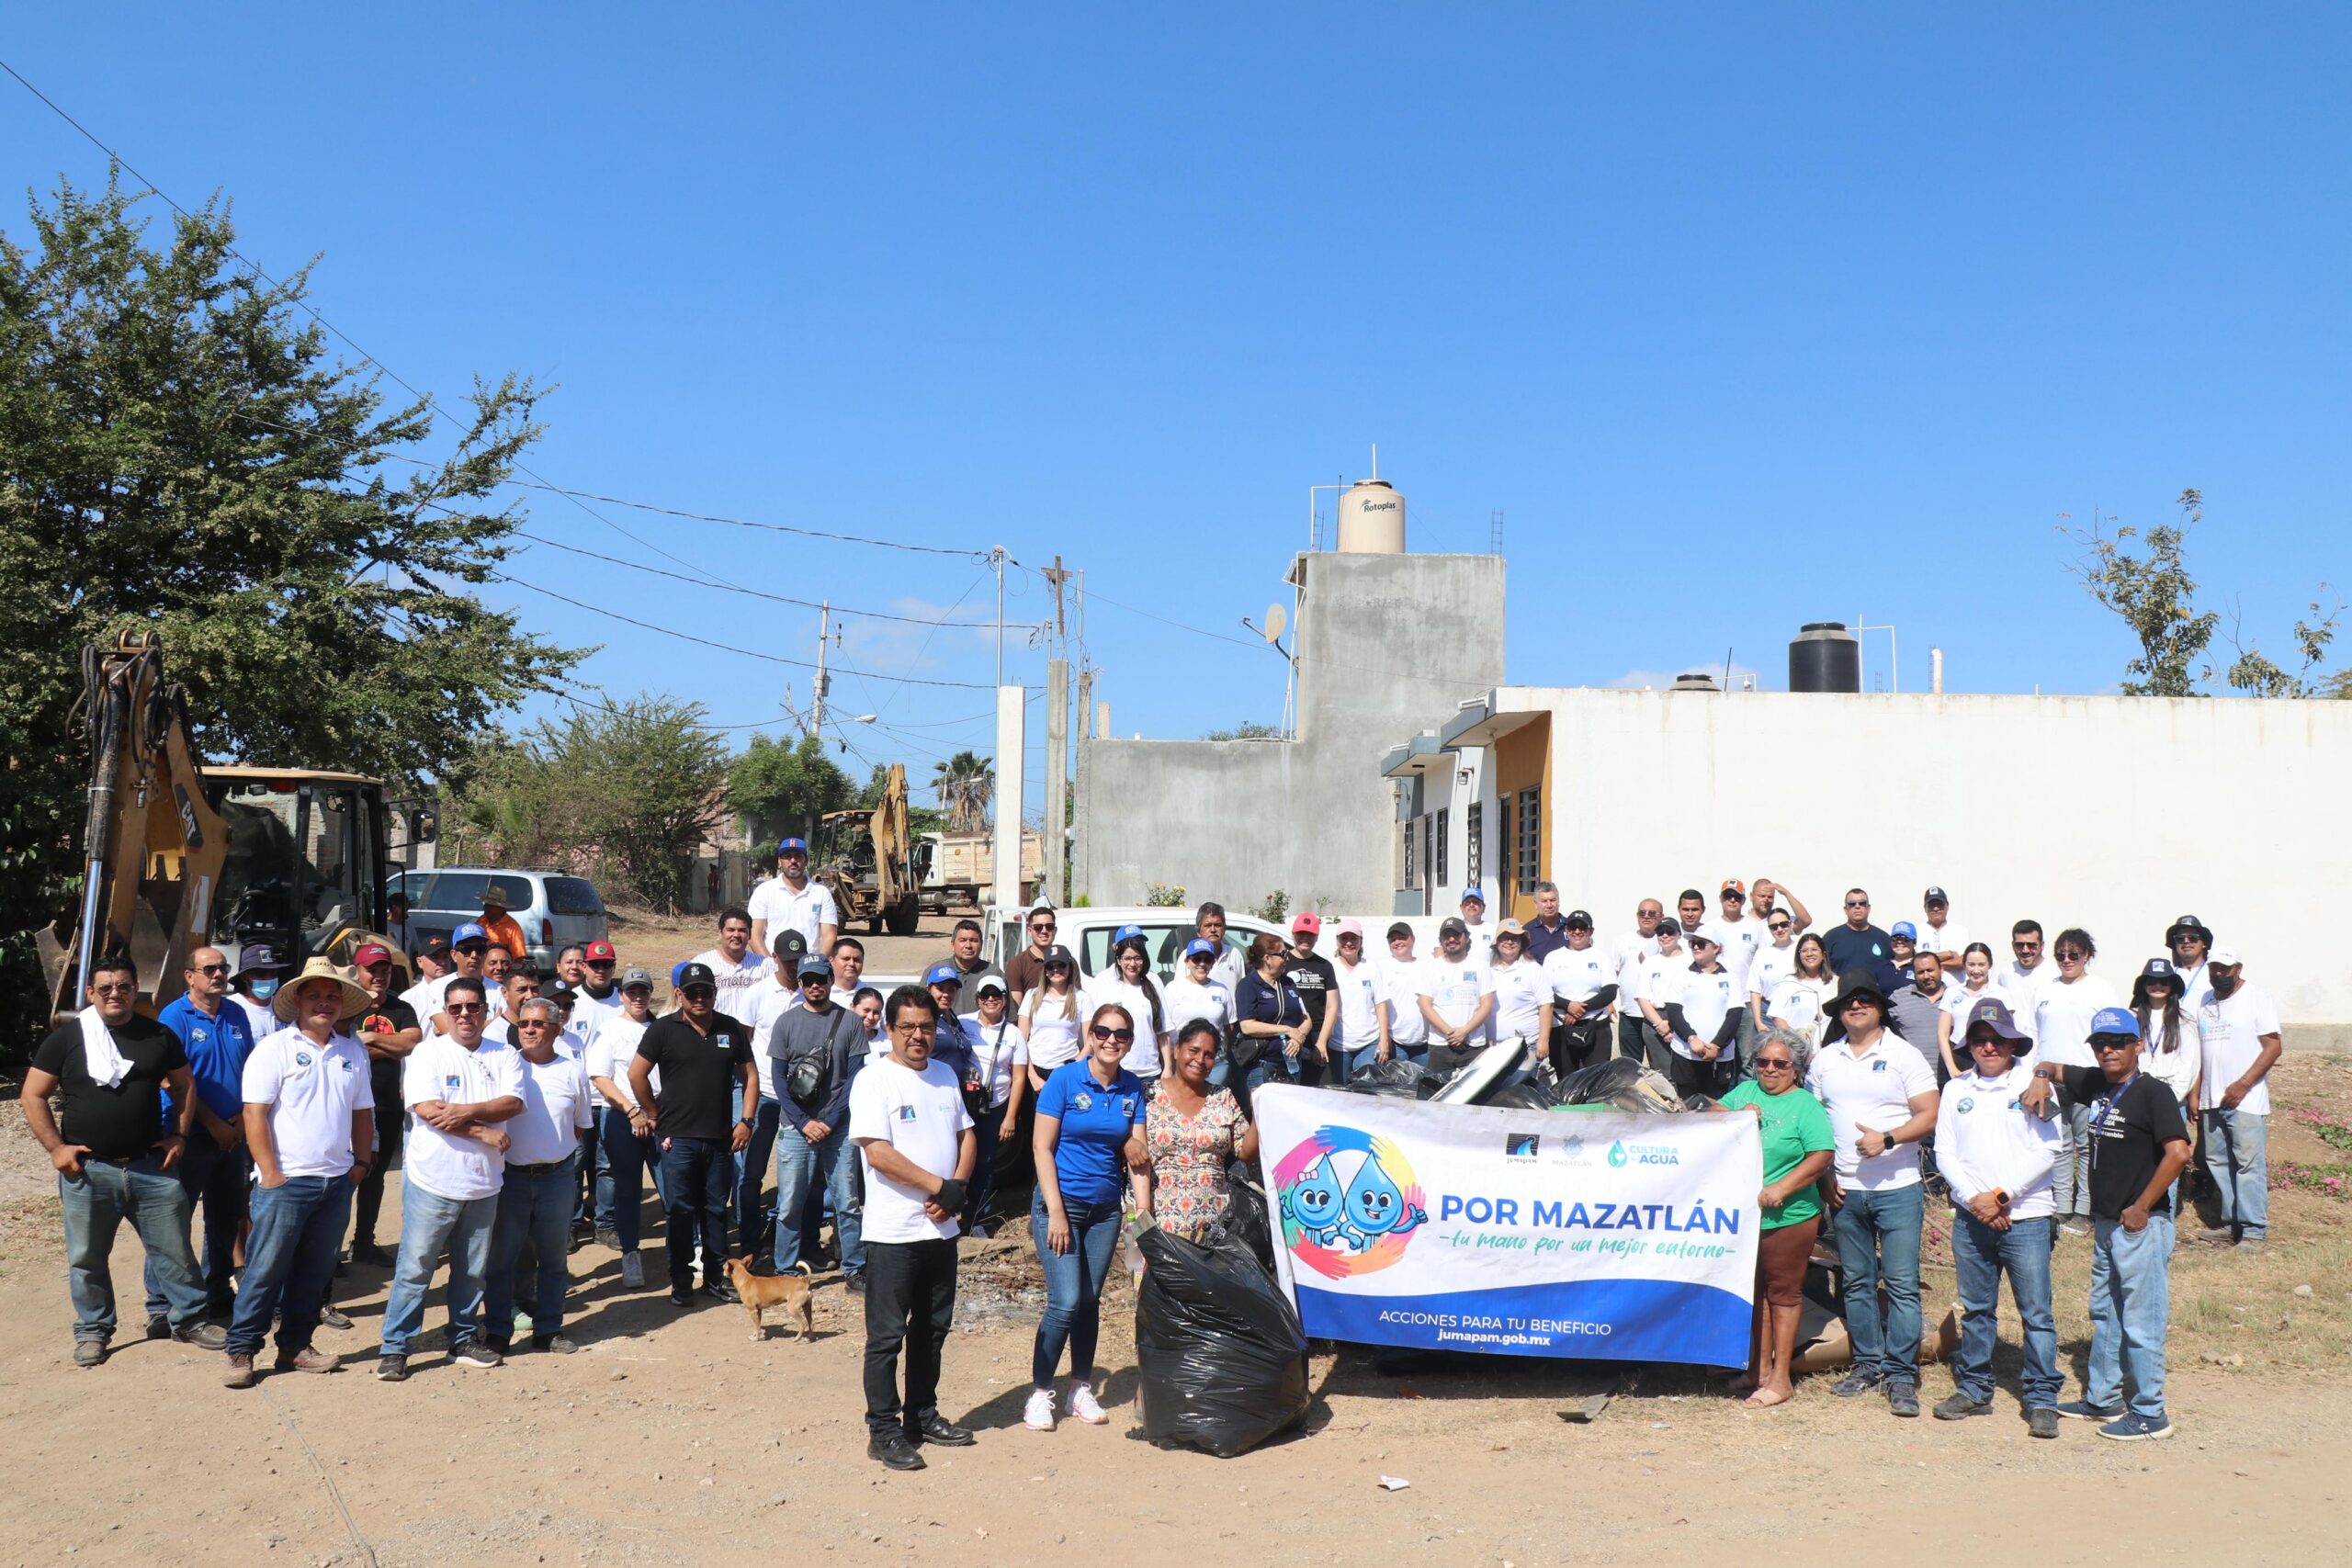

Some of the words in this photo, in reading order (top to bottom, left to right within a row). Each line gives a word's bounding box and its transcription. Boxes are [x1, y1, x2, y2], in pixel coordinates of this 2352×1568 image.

[1363, 501, 1396, 513] Rotoplas
[182, 800, 197, 840] CAT
[1050, 946, 1058, 955] B
[803, 955, 820, 964] DAD
[1629, 1145, 1679, 1155] CULTURA
[1639, 1154, 1679, 1166] AGUA
[1441, 1195, 1519, 1225] POR
[1532, 1198, 1739, 1235] MAZATLÁN
[1476, 1233, 1527, 1249] mano
[1534, 1236, 1564, 1256] por
[1571, 1239, 1592, 1251] un
[1598, 1237, 1648, 1259] mejor
[1379, 1310, 1457, 1327] ACCIONES
[1462, 1315, 1503, 1330] PARA
[1507, 1317, 1526, 1330] TU
[1531, 1319, 1611, 1336] BENEFICIO
[1437, 1328, 1551, 1346] jumapam.gob.mx
